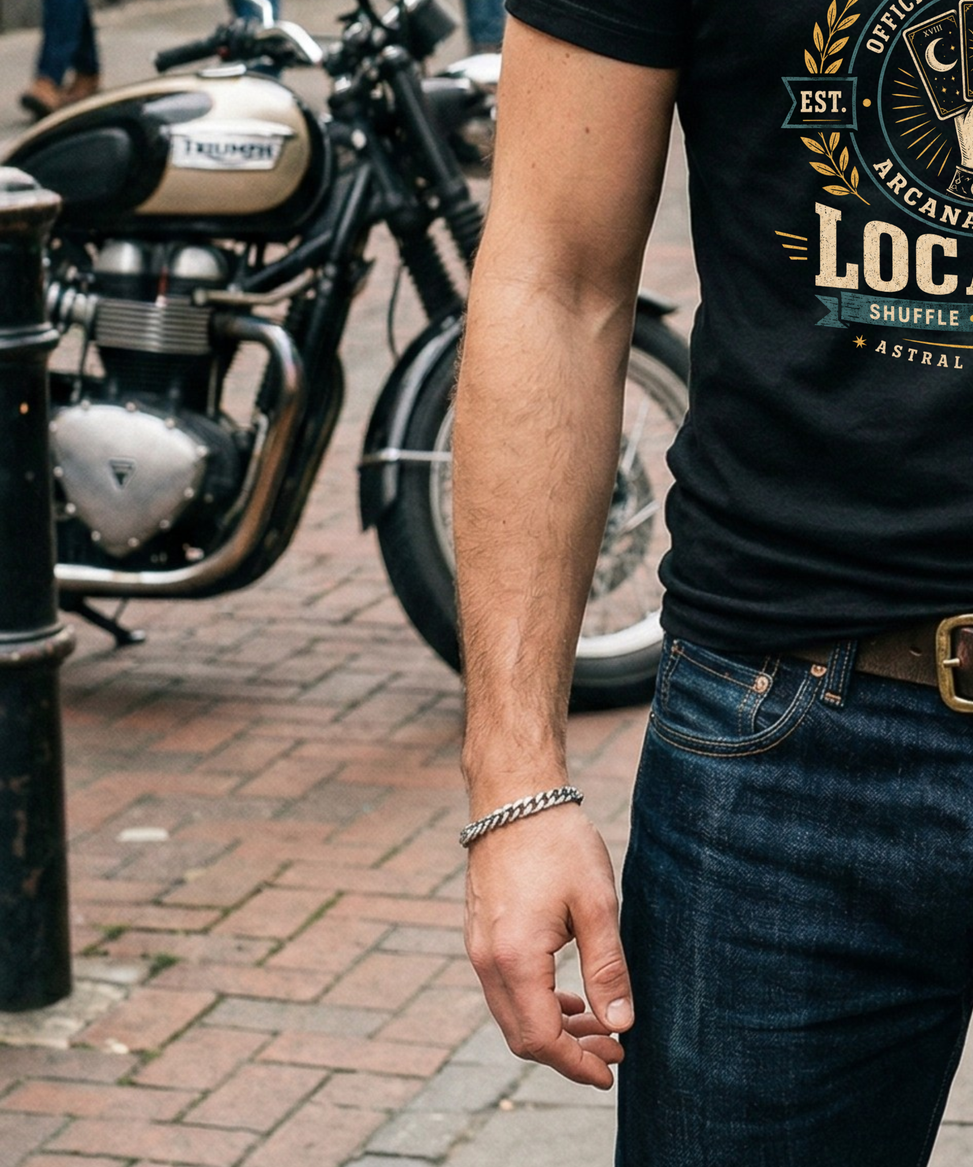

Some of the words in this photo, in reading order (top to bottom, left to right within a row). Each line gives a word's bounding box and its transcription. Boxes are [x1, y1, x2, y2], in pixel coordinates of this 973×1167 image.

[801, 91, 846, 112] EST.
[870, 304, 958, 325] SHUFFLE
[875, 340, 964, 369] ASTRAL
